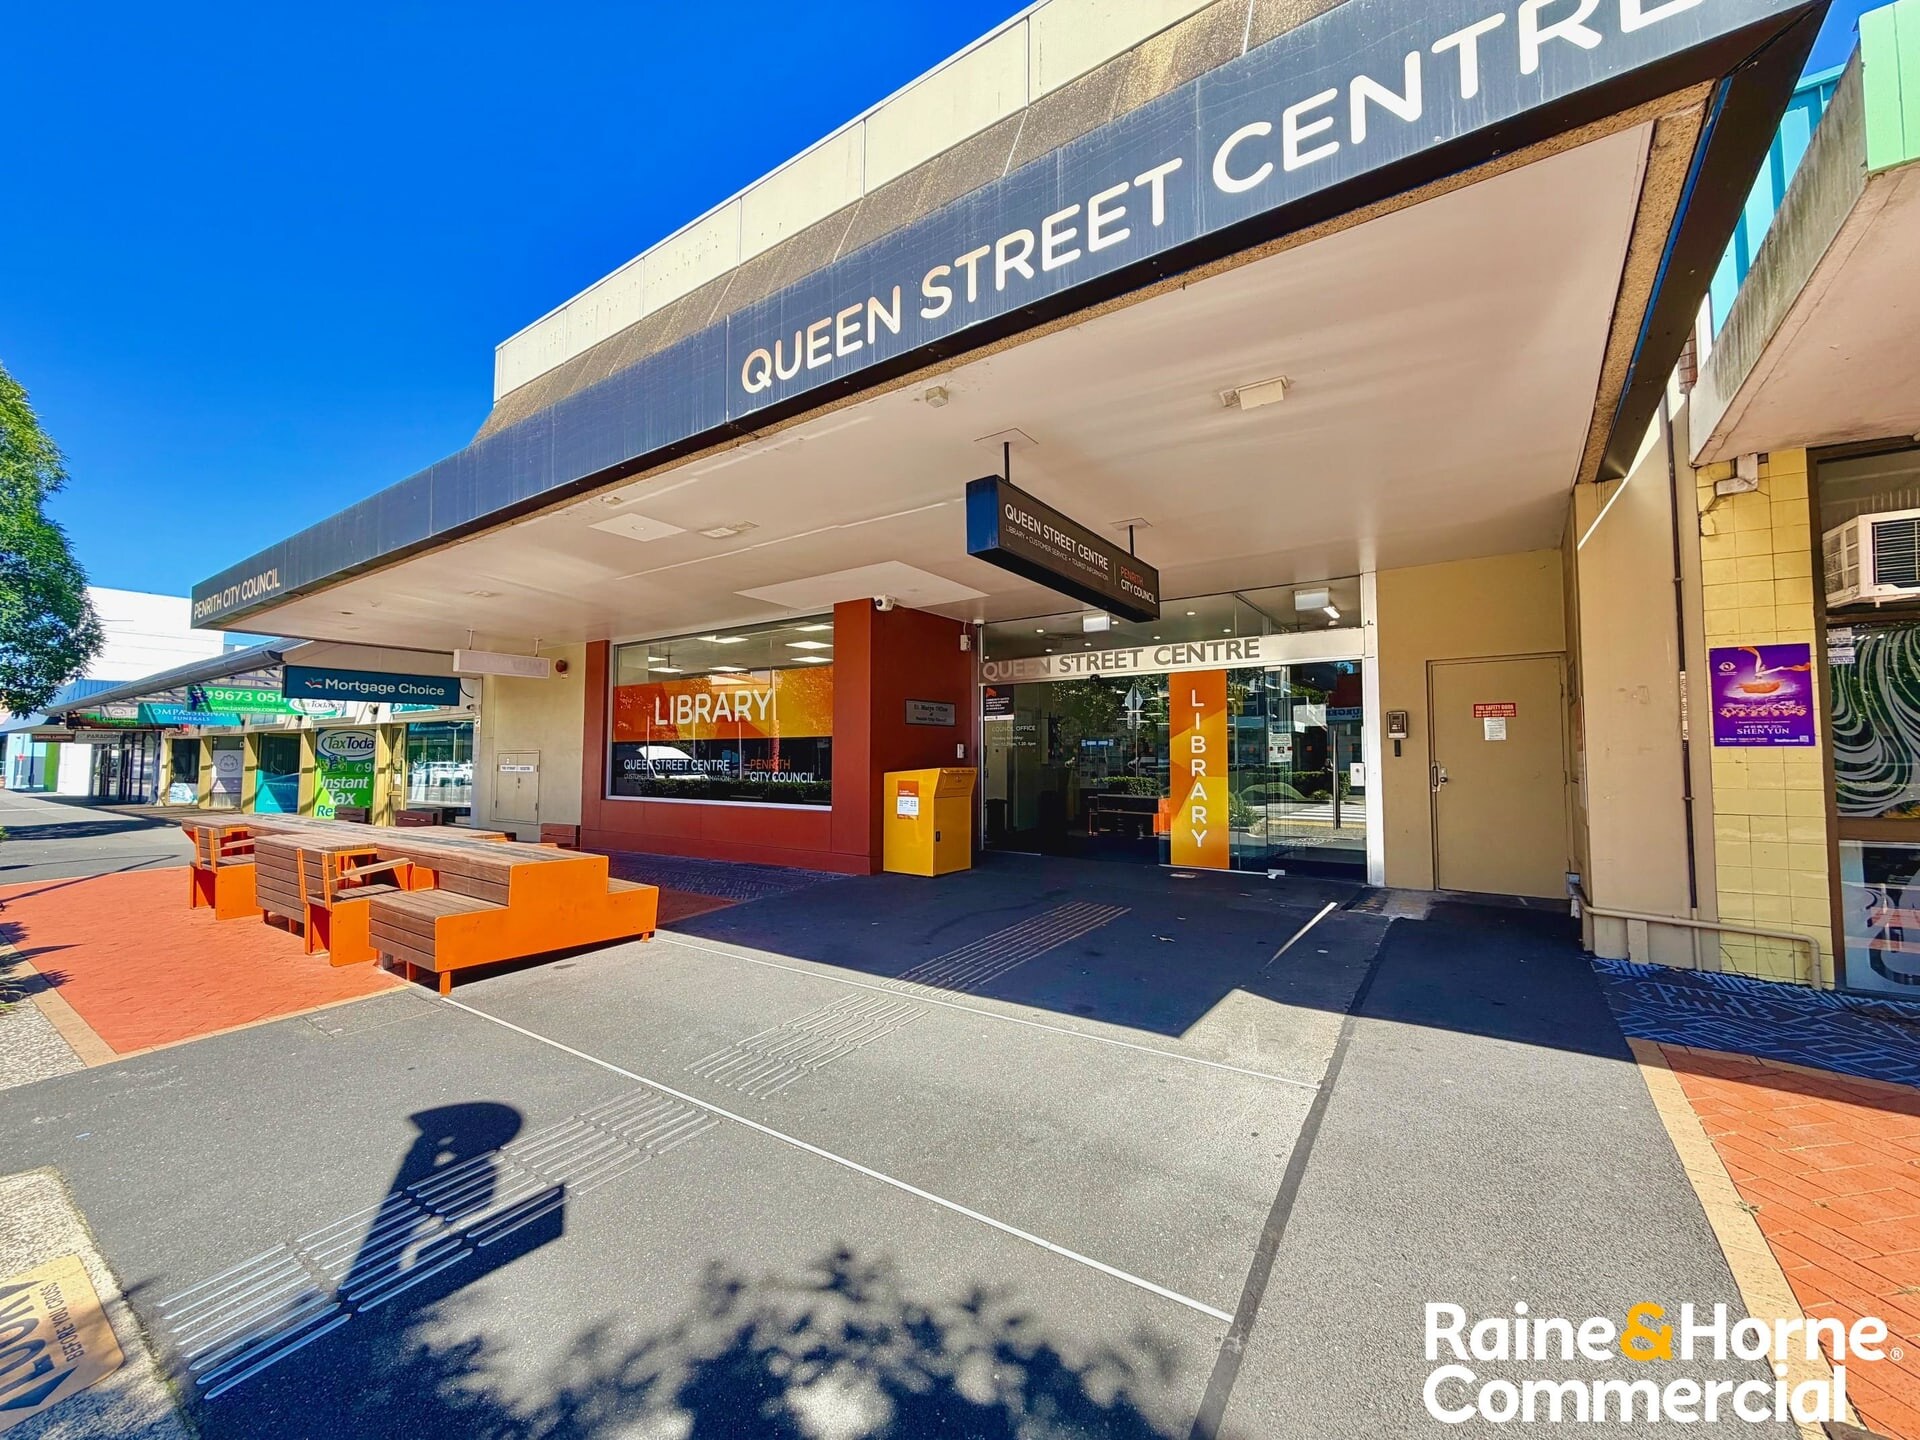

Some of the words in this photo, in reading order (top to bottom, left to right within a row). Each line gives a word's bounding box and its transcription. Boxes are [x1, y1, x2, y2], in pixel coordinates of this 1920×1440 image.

[741, 285, 901, 394] QUEEN
[920, 157, 1183, 319] STREET
[1004, 503, 1041, 535] QUEEN
[1043, 524, 1077, 553] STREET
[1078, 543, 1109, 570] CENTRE
[1005, 524, 1026, 539] LIBRARY
[1120, 566, 1144, 586] PENRITH
[194, 591, 222, 620] PENRITH
[223, 583, 241, 608] CITY
[241, 567, 281, 601] COUNCIL
[1120, 578, 1134, 593] CITY
[1133, 585, 1157, 604] COUNCIL
[982, 655, 1052, 683] QUEEN
[1058, 648, 1145, 674] STREET
[1153, 637, 1261, 667] CENTRE
[215, 690, 253, 703] 9673
[325, 678, 396, 695] Mortgage
[398, 683, 446, 697] Choice
[654, 688, 774, 726] LIBRARY
[624, 759, 651, 771] QUEEN
[655, 759, 689, 771] STREET
[691, 759, 730, 772] CENTRE
[750, 771, 772, 782] CITY
[772, 772, 816, 784] COUNCIL
[1190, 688, 1209, 848] LIBRARY
[321, 775, 369, 789] Instant
[328, 789, 357, 805] Tax
[39, 1281, 66, 1309] CROSS
[48, 1306, 72, 1328] YOU
[54, 1324, 85, 1363] BEFORE
